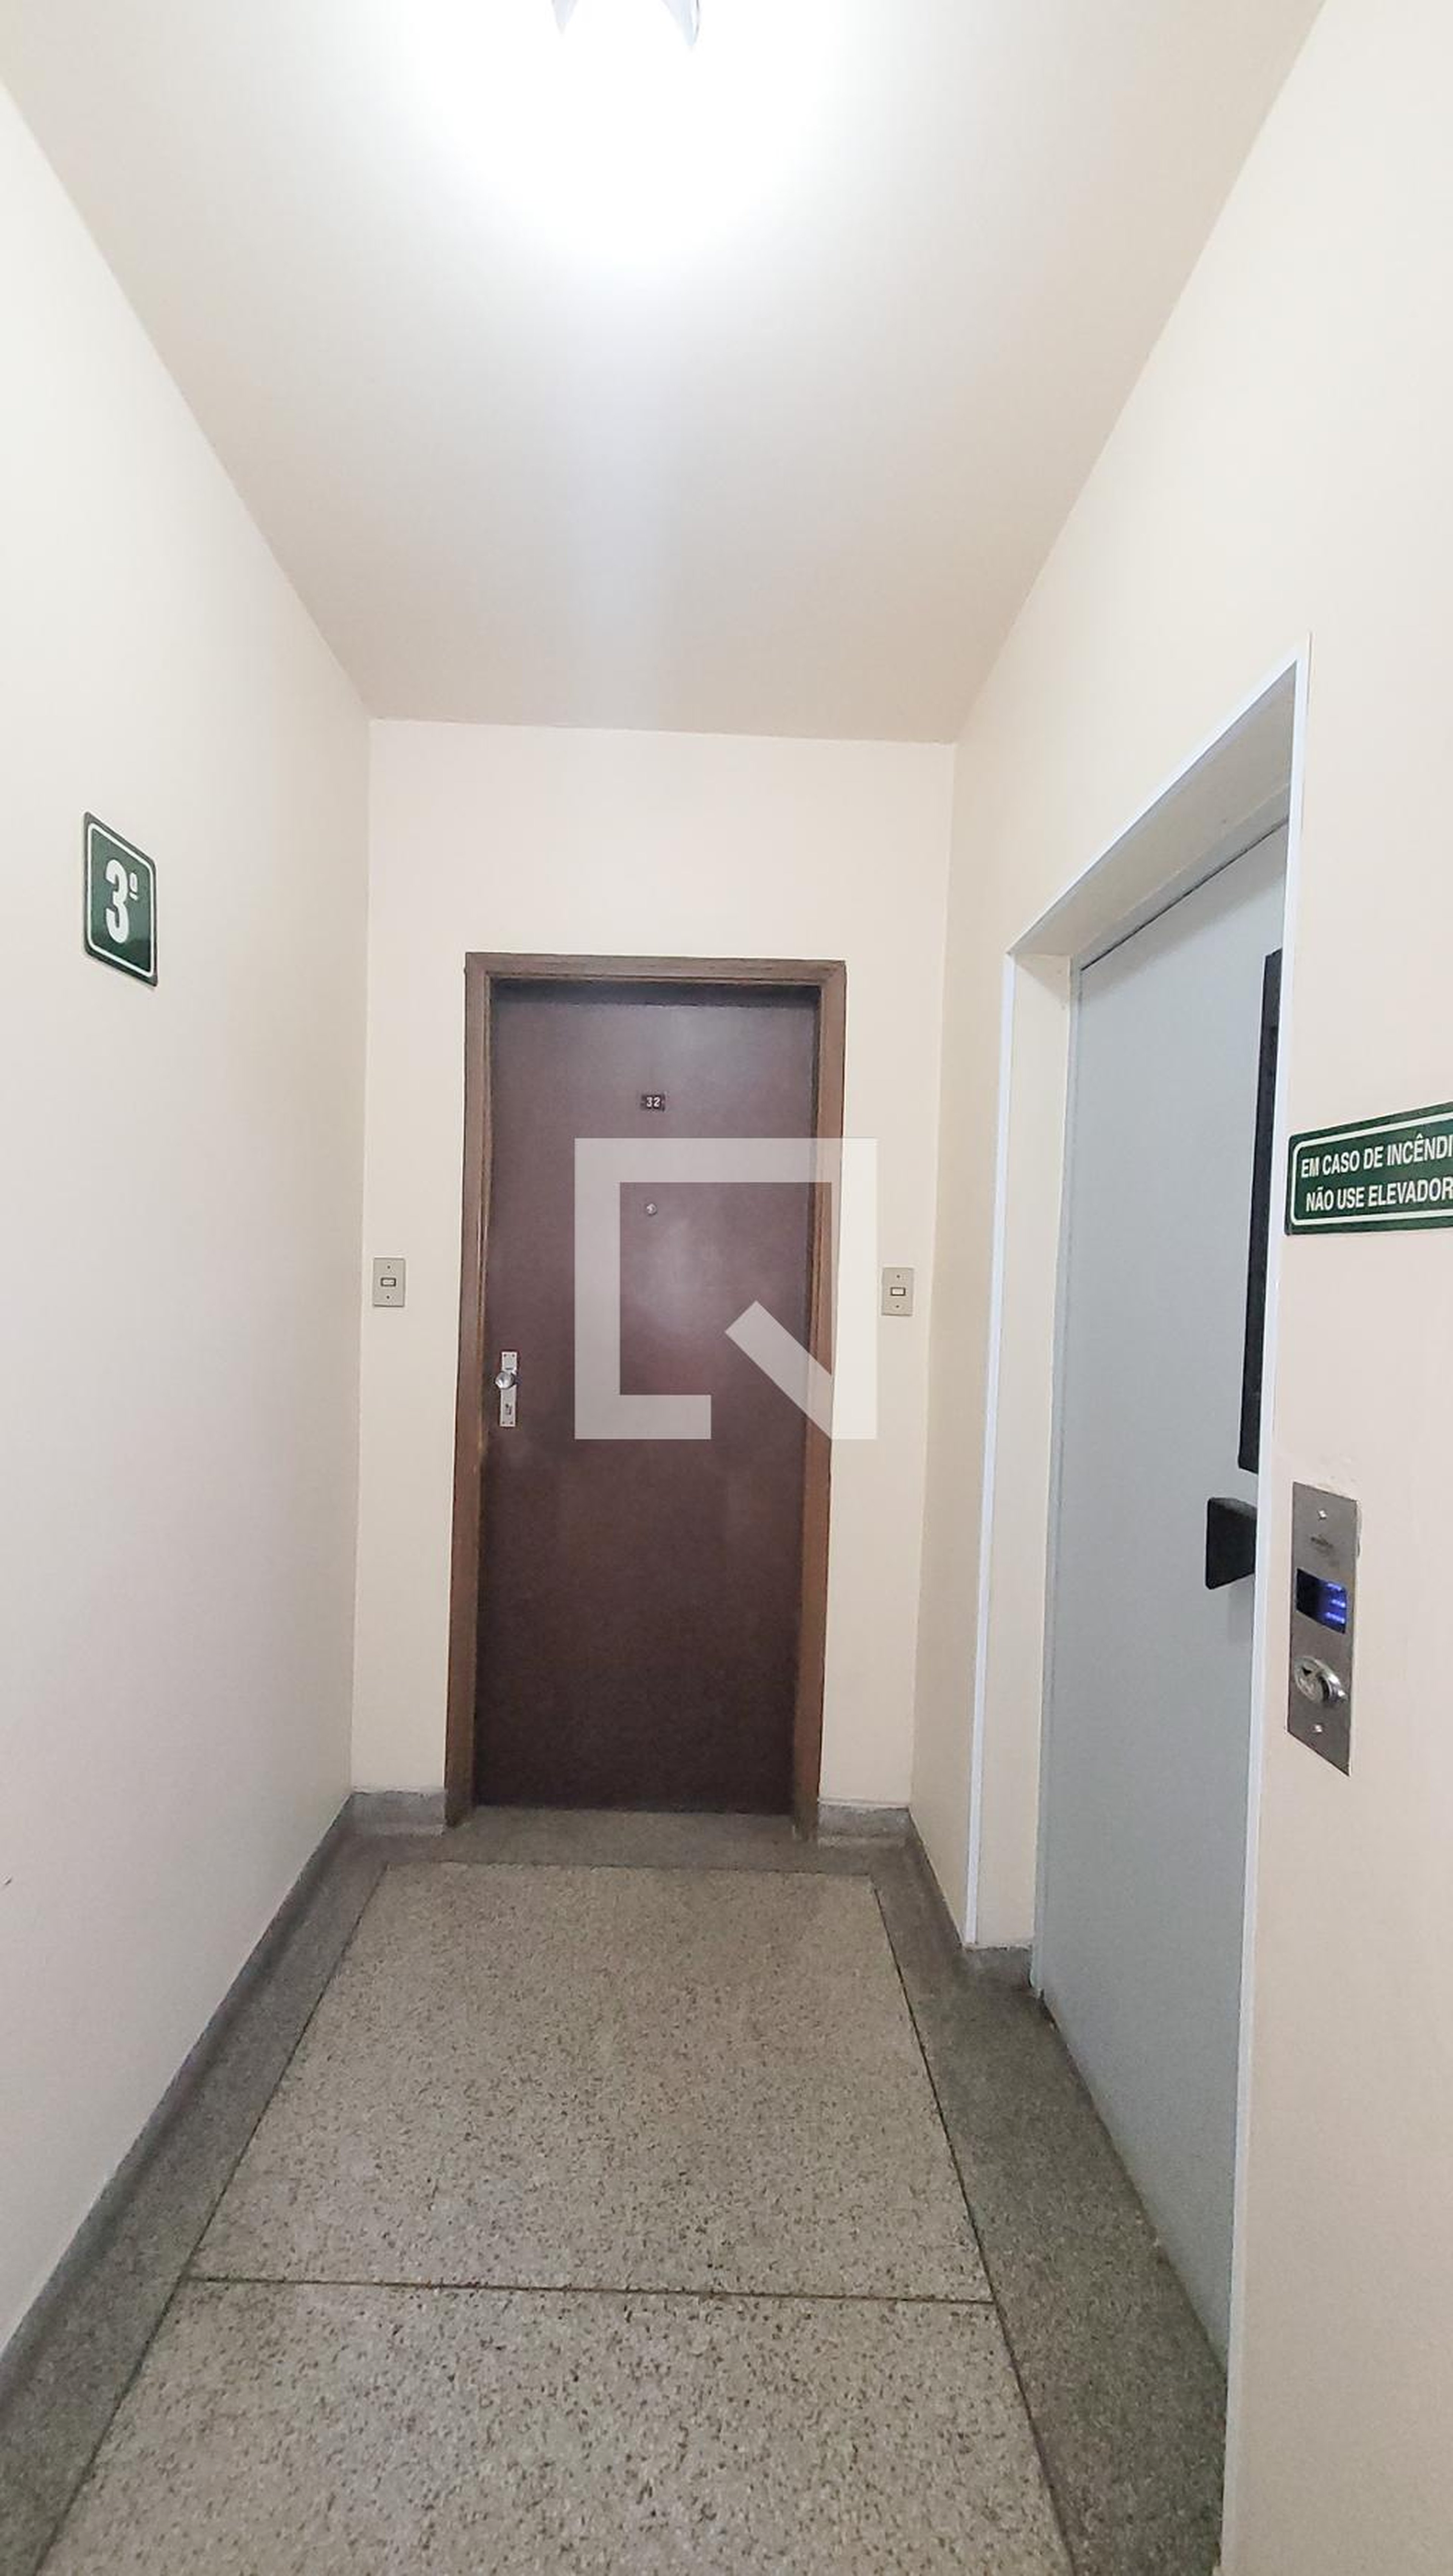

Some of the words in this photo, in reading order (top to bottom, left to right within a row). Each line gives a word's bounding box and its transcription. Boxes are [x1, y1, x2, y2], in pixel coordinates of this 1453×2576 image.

[646, 1096, 661, 1107] 32
[1301, 1156, 1319, 1178] EM
[1322, 1150, 1360, 1175] CASO
[1363, 1146, 1384, 1170] DE
[1306, 1187, 1334, 1212] NÃO
[1337, 1187, 1365, 1209] USE
[1368, 1176, 1453, 1206] ELEVADOR
